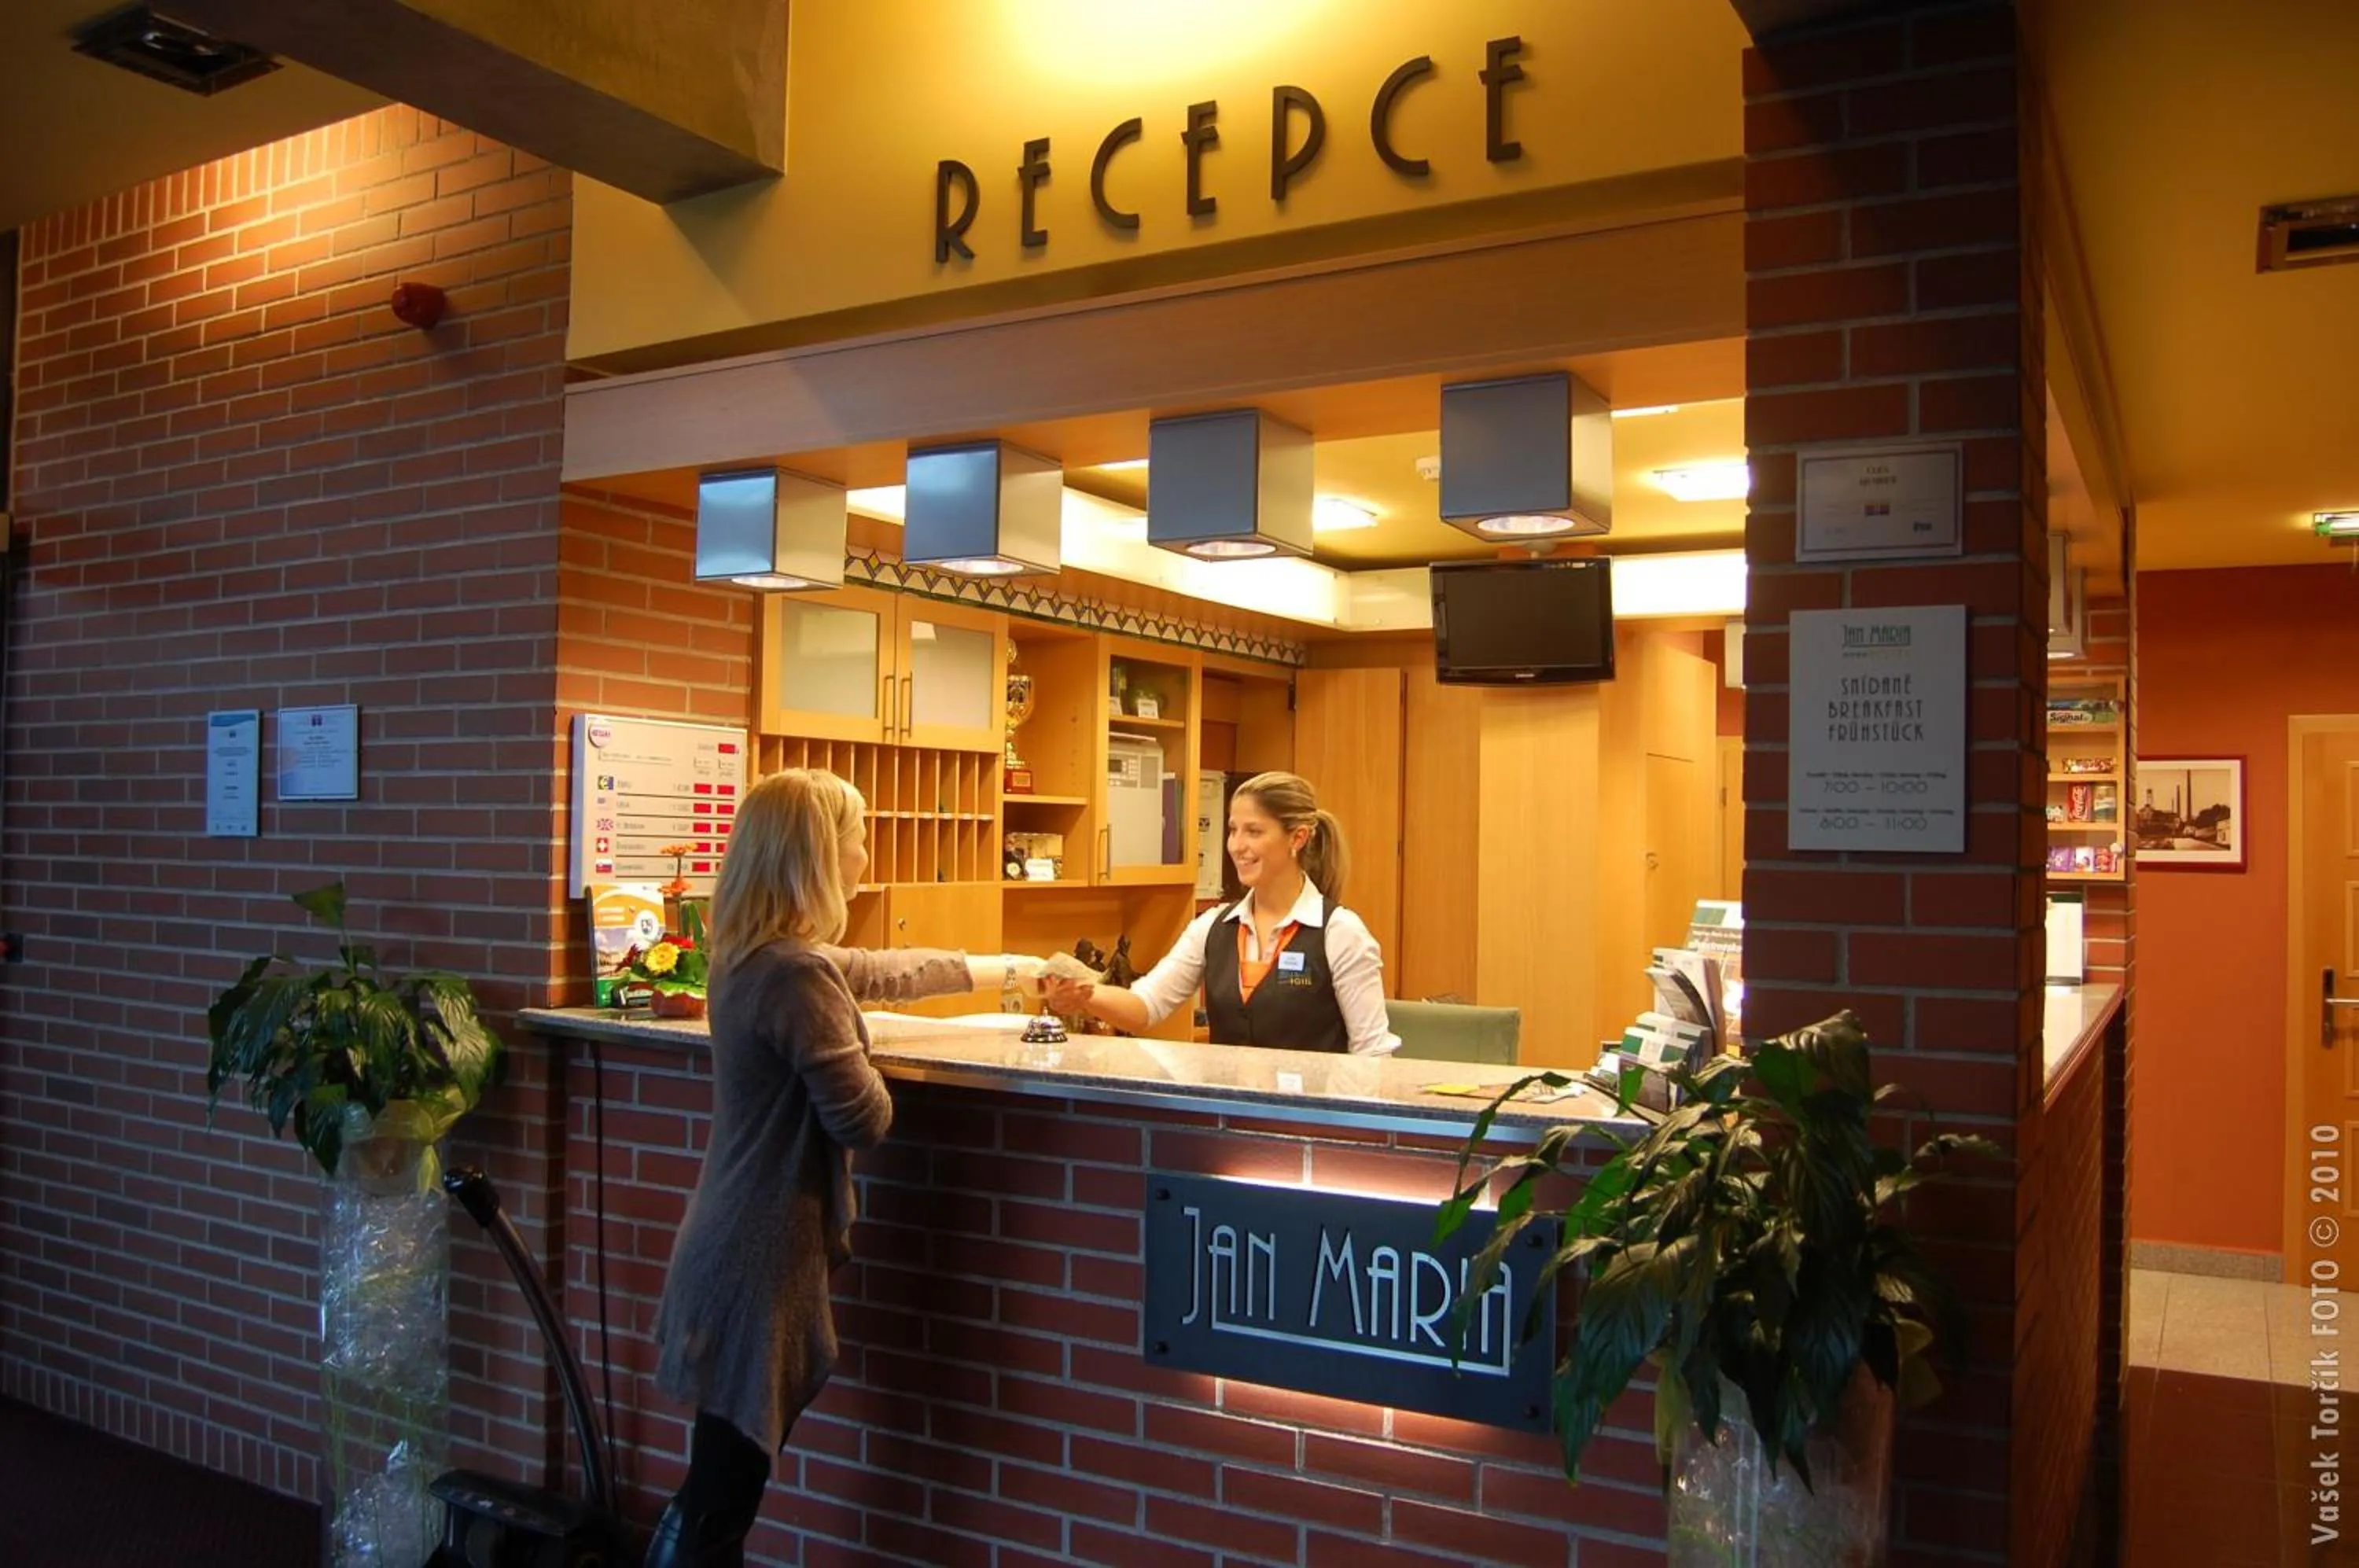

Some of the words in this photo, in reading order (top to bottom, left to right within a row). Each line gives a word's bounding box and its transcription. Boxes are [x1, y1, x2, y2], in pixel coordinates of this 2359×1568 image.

[935, 35, 1525, 263] RECEPCE
[1842, 624, 1864, 648] JAN
[1869, 624, 1912, 646] MARIA
[1828, 699, 1923, 719] BREAKFAST
[1828, 721, 1924, 742] FRÜHSTÜCK
[1182, 1207, 1275, 1329] JAN
[1308, 1226, 1512, 1376] MARIA
